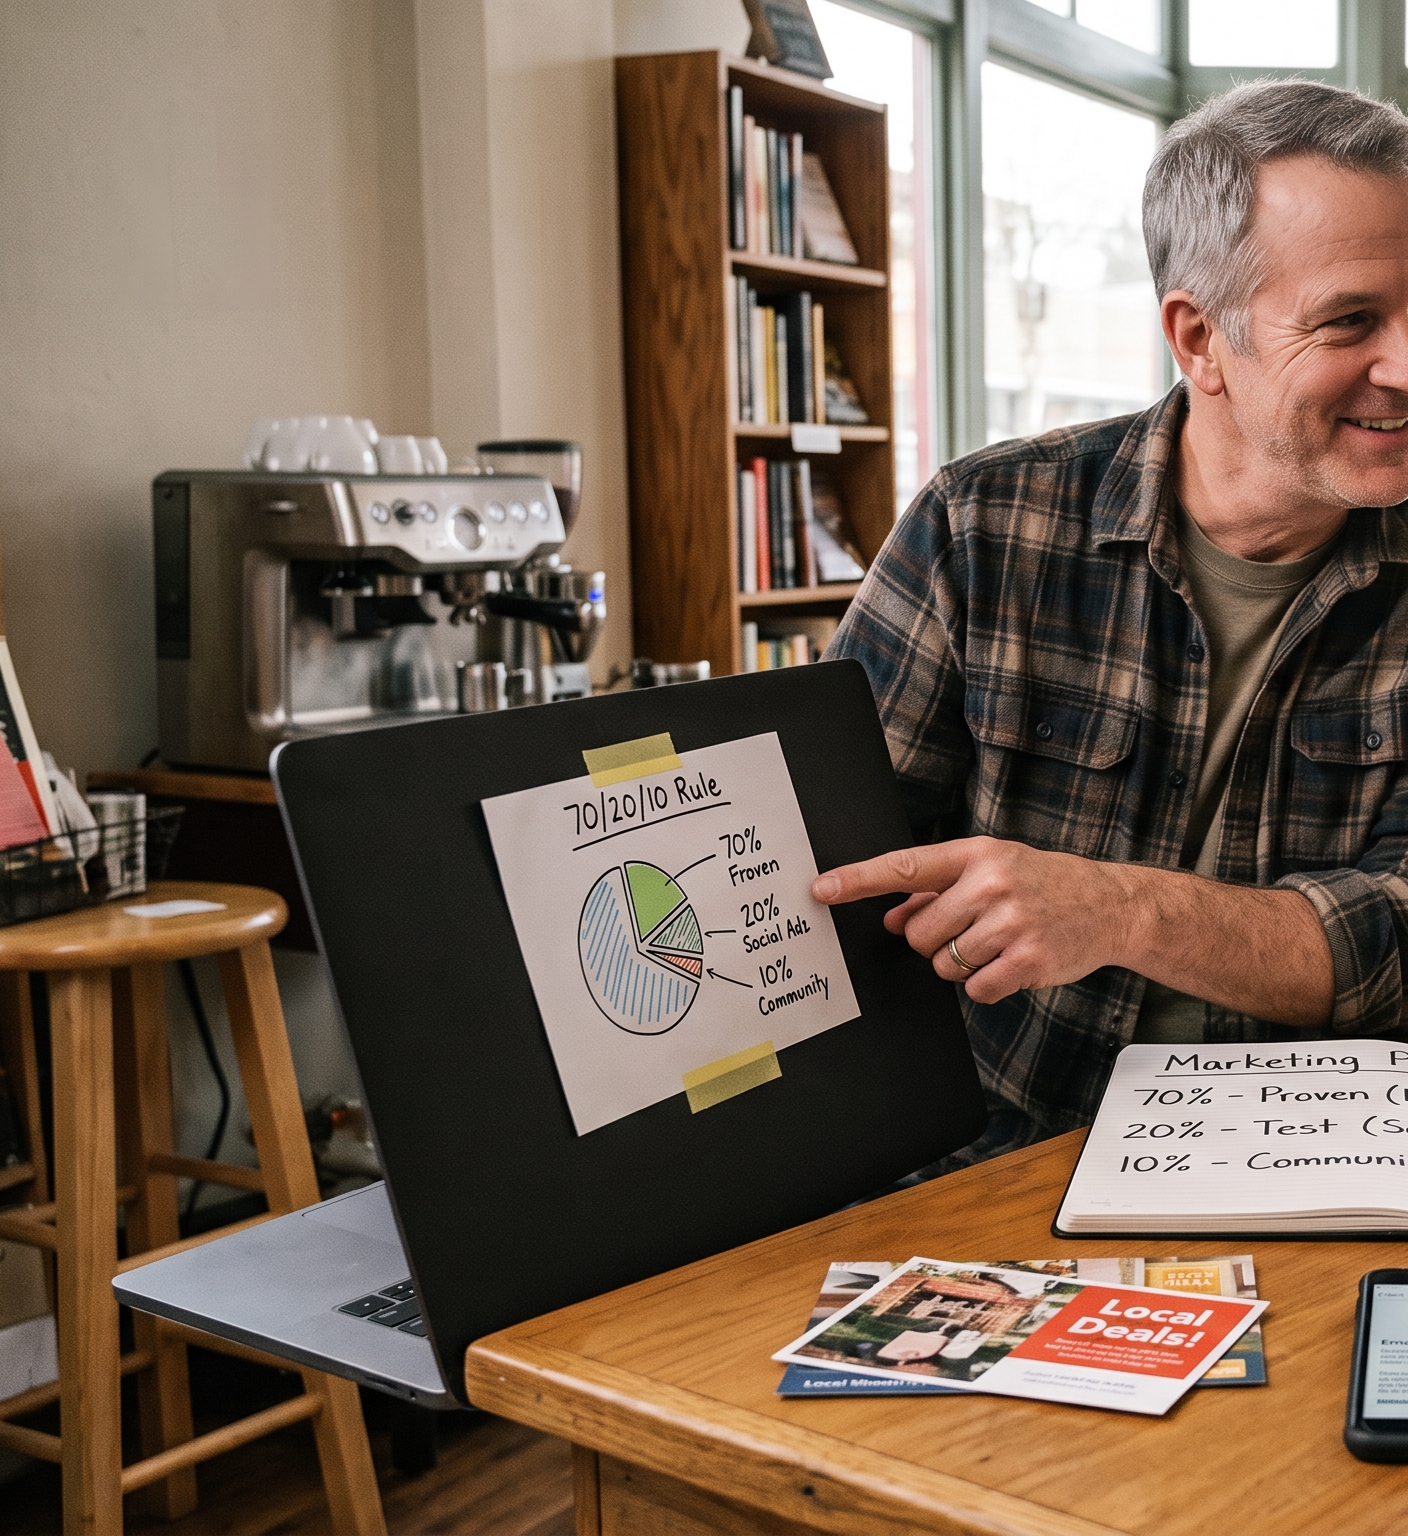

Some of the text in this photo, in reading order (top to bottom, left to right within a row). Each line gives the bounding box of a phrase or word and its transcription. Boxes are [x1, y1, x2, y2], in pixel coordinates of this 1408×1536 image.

[563, 772, 722, 835] 70/20/10 Rule
[719, 826, 761, 859] 70%
[741, 893, 779, 927] 20%
[743, 924, 783, 953] Social
[759, 955, 792, 988] 10%
[759, 973, 828, 1015] Community
[1164, 1053, 1360, 1073] Marketing
[1134, 1087, 1213, 1105] 70%
[1261, 1086, 1369, 1102] Proven
[1123, 1121, 1203, 1138] 20%
[1254, 1119, 1337, 1135] Test
[1121, 1154, 1190, 1172] 10%
[1098, 1298, 1214, 1327] Local
[1066, 1316, 1206, 1348] Deals!
